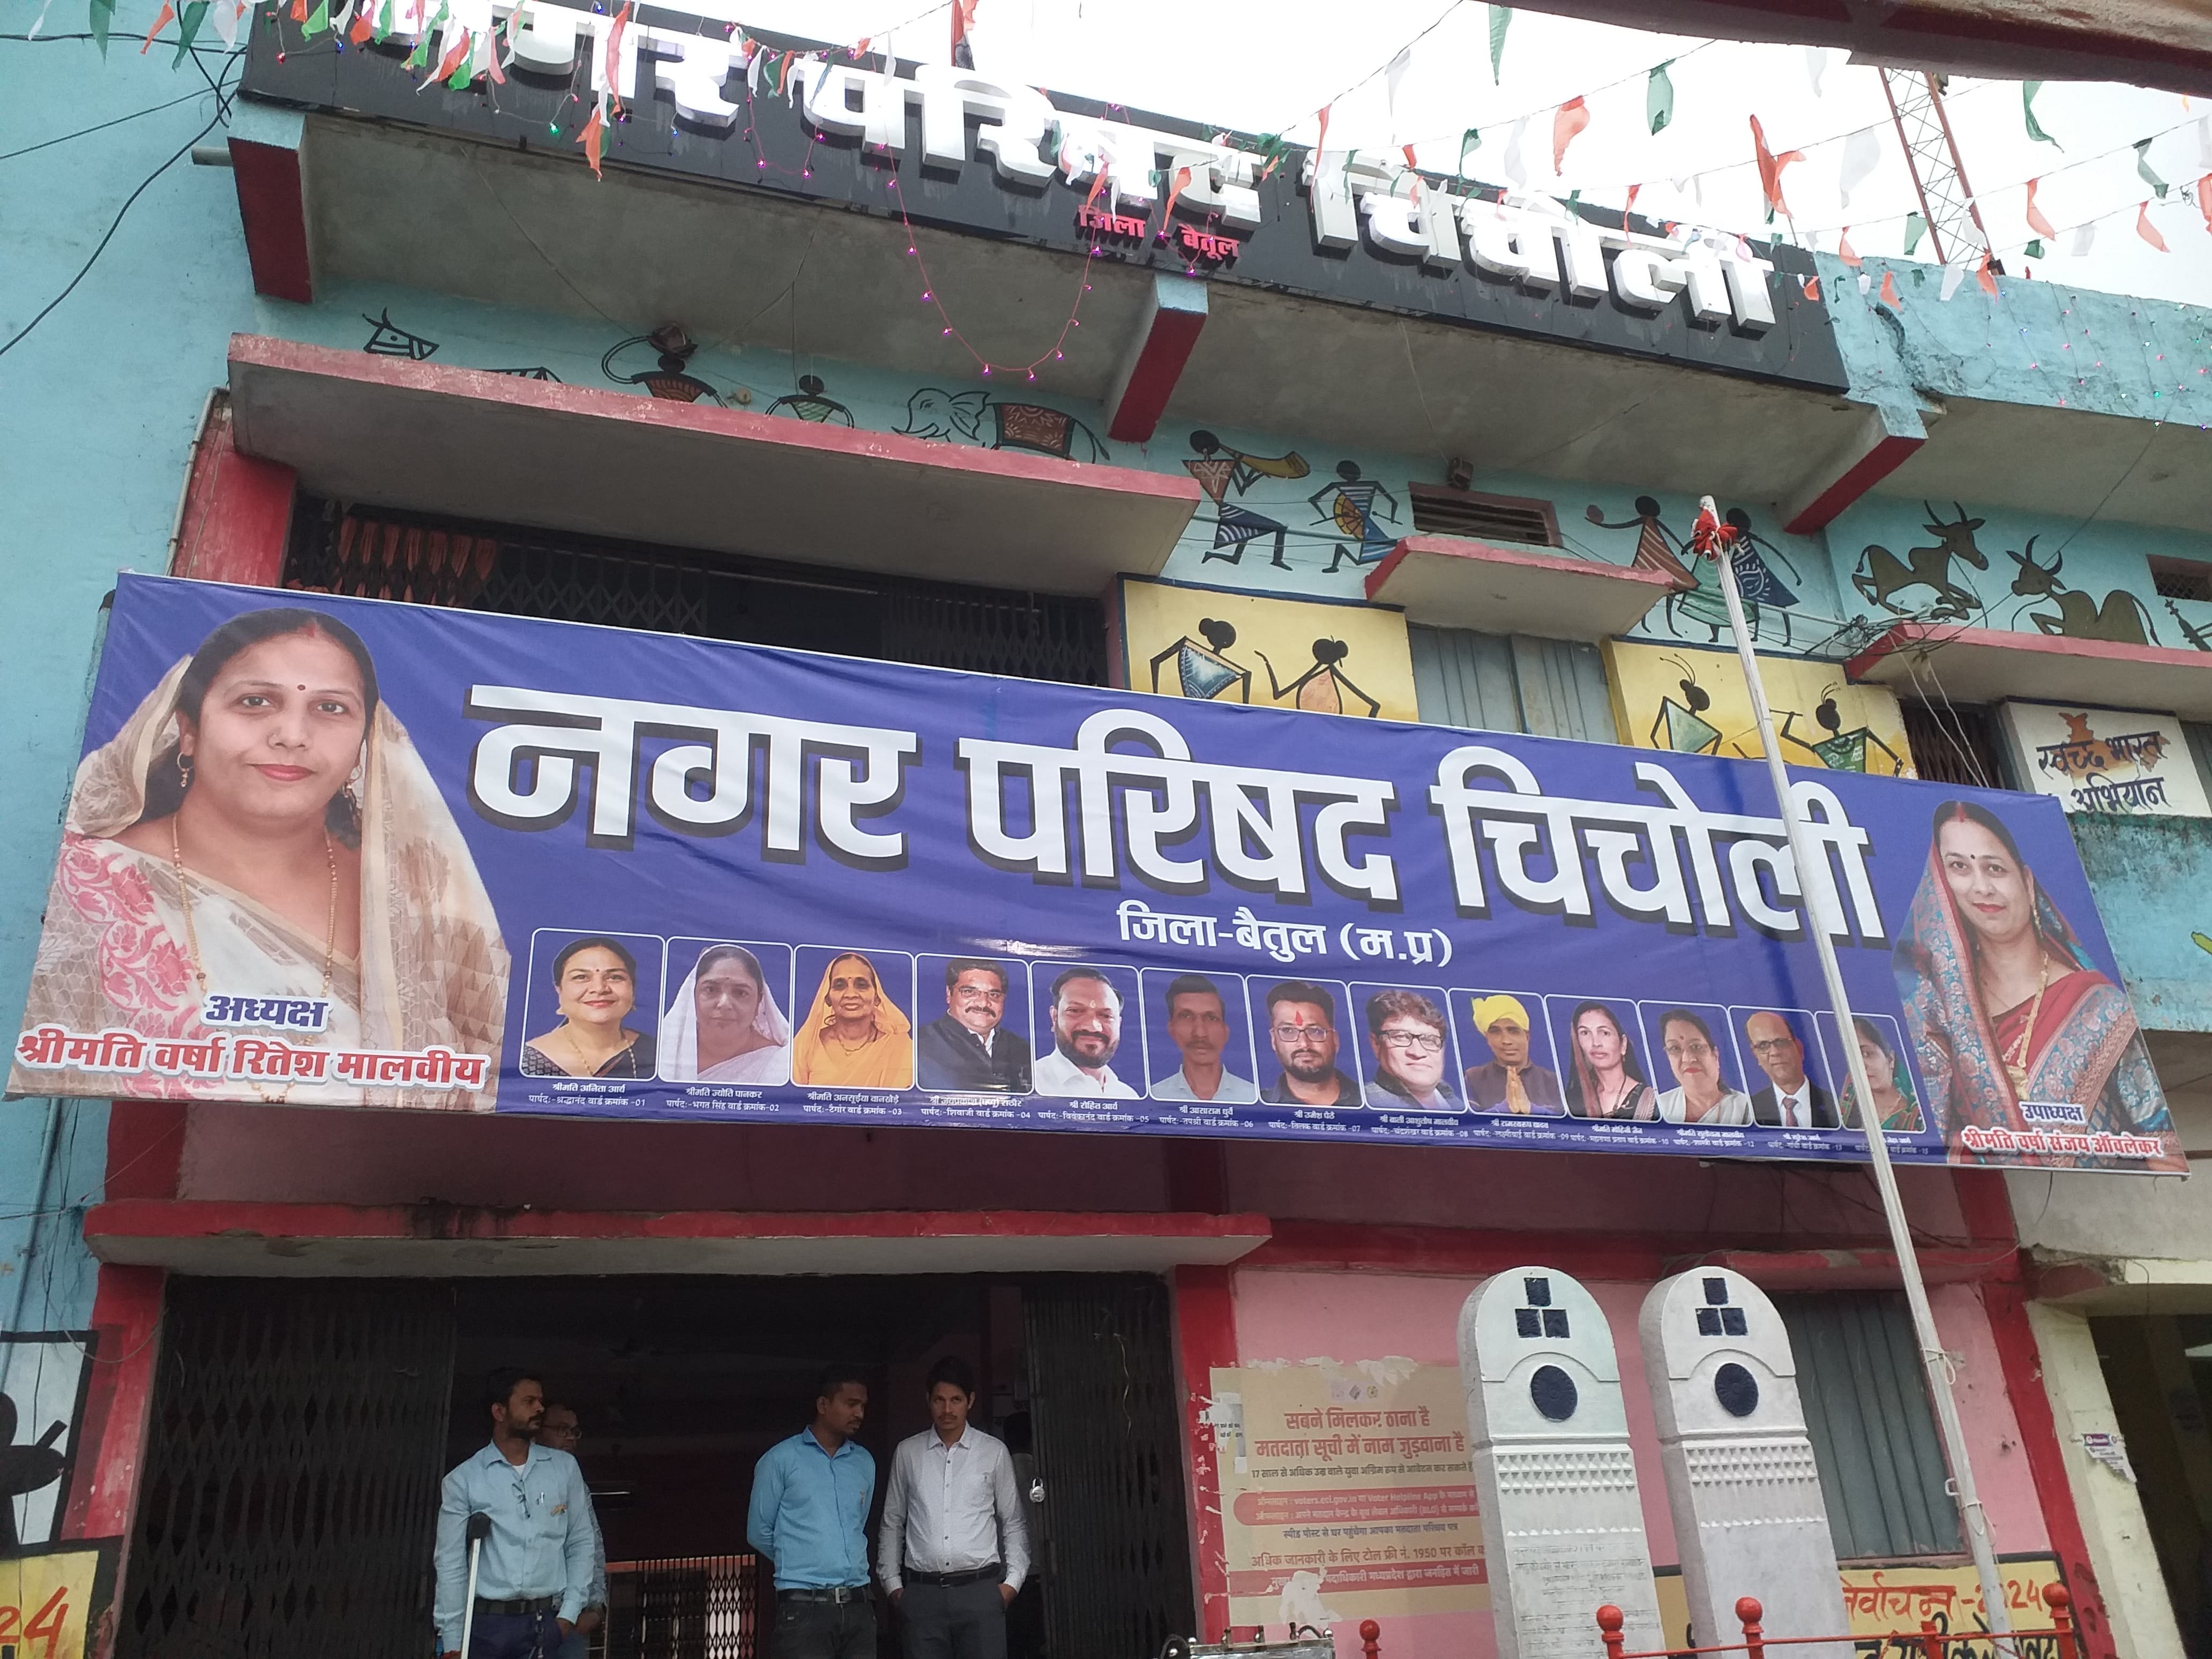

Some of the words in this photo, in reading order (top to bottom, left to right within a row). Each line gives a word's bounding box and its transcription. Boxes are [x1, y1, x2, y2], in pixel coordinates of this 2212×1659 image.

[1078, 204, 1146, 238] जिला
[1302, 149, 1777, 332] चिचोली
[2105, 730, 2170, 763] भारत
[2070, 771, 2172, 812] अभियान
[469, 684, 917, 860] नगर
[959, 708, 1402, 901] परिषद
[1430, 745, 1885, 939] चिचोली
[1340, 922, 1453, 968] (म.प्र)
[205, 995, 330, 1028] अध्यक्ष
[16, 1029, 147, 1066] श्रीमति
[150, 1037, 224, 1072] वर्षा
[233, 1039, 331, 1079] रितेश
[337, 1049, 485, 1086] मालवीय
[552, 1082, 578, 1093] श्रीमति
[579, 1083, 606, 1093] अनिता
[608, 1083, 626, 1093] आर्य
[685, 1086, 710, 1096] श्रीमति
[712, 1087, 734, 1097] ज्योति
[735, 1090, 763, 1098] पानकर
[587, 1095, 603, 1105] वार्ड
[604, 1096, 629, 1106] क्रमांक
[630, 1098, 645, 1107] -01
[806, 1091, 832, 1102] श्रीमति
[1069, 1100, 1078, 1109] श्री
[1080, 1101, 1101, 1110] रोहित
[1102, 1102, 1118, 1110] आर्य
[711, 1100, 726, 1111] सिंह
[727, 1100, 742, 1111] वार्ड
[847, 1104, 862, 1115] वार्ड
[862, 1105, 887, 1115] क्रमांक
[887, 1108, 902, 1116] -03
[976, 1108, 990, 1118] वार्ड
[991, 1109, 1014, 1119] क्रमांक
[1016, 1111, 1031, 1119] -04
[1179, 1105, 1188, 1114] श्री
[1294, 1109, 1303, 1119] श्री
[2020, 1103, 2084, 1122] उपाध्यक्ष
[1096, 1112, 1111, 1122] वार्ड
[1111, 1113, 1134, 1122] क्रमांक
[1135, 1115, 1150, 1123] -05
[1202, 1116, 1217, 1127] वार्ड
[1217, 1118, 1239, 1127] क्रमांक
[1963, 1127, 2015, 1150] श्रीमति
[2015, 1130, 2047, 1151] वर्षा
[2046, 1132, 2090, 1153] संजय
[1284, 1407, 1324, 1431] सबने
[1325, 1407, 1382, 1430] मिलकर
[1384, 1409, 1418, 1428] ठाना
[1418, 1405, 1430, 1426] है
[1254, 1439, 1310, 1458] मतदाता
[1311, 1433, 1343, 1462] सूची
[1344, 1433, 1361, 1455] में
[1362, 1437, 1395, 1455] नाम
[1396, 1436, 1452, 1460] जुड़वाना
[1451, 1432, 1465, 1453] है
[1252, 1470, 1260, 1478] 17
[1260, 1469, 1279, 1478] साल
[1280, 1466, 1288, 1477] से
[1288, 1466, 1313, 1477] अधिक
[1327, 1465, 1343, 1476] वाले
[1343, 1467, 1359, 1478] युवा
[1397, 1463, 1405, 1474] से
[1406, 1463, 1433, 1474] आवेदन
[1433, 1464, 1446, 1473] कर
[1446, 1462, 1467, 1473] सकते
[1368, 1494, 1389, 1502] Voter
[1390, 1492, 1422, 1502] Helpline
[1423, 1492, 1438, 1500] App
[1282, 1527, 1302, 1539] स्पीड
[1302, 1527, 1320, 1538] पोस्ट
[1321, 1526, 1329, 1538] से
[1331, 1528, 1341, 1538] घर
[1369, 1526, 1394, 1536] आपका
[1394, 1525, 1421, 1534] मतदाता
[1446, 1522, 1459, 1531] पत्र
[1251, 1551, 1282, 1566] अधिक
[1283, 1549, 1326, 1565] जानकारी
[1327, 1548, 1338, 1564] के
[1340, 1548, 1360, 1563] लिए
[1362, 1547, 1381, 1561] टोल
[1383, 1545, 1398, 1560] फ्री
[1399, 1546, 1411, 1559] नं.
[1413, 1547, 1437, 1559] 1950
[1439, 1546, 1452, 1557] पर
[1453, 1543, 1475, 1557] कॉल
[1325, 1568, 1367, 1585] पदाधिकारी
[1367, 1567, 1404, 1581] मध्यप्रदेश
[1405, 1570, 1423, 1581] द्वारा
[1461, 1563, 1479, 1576] जारी
